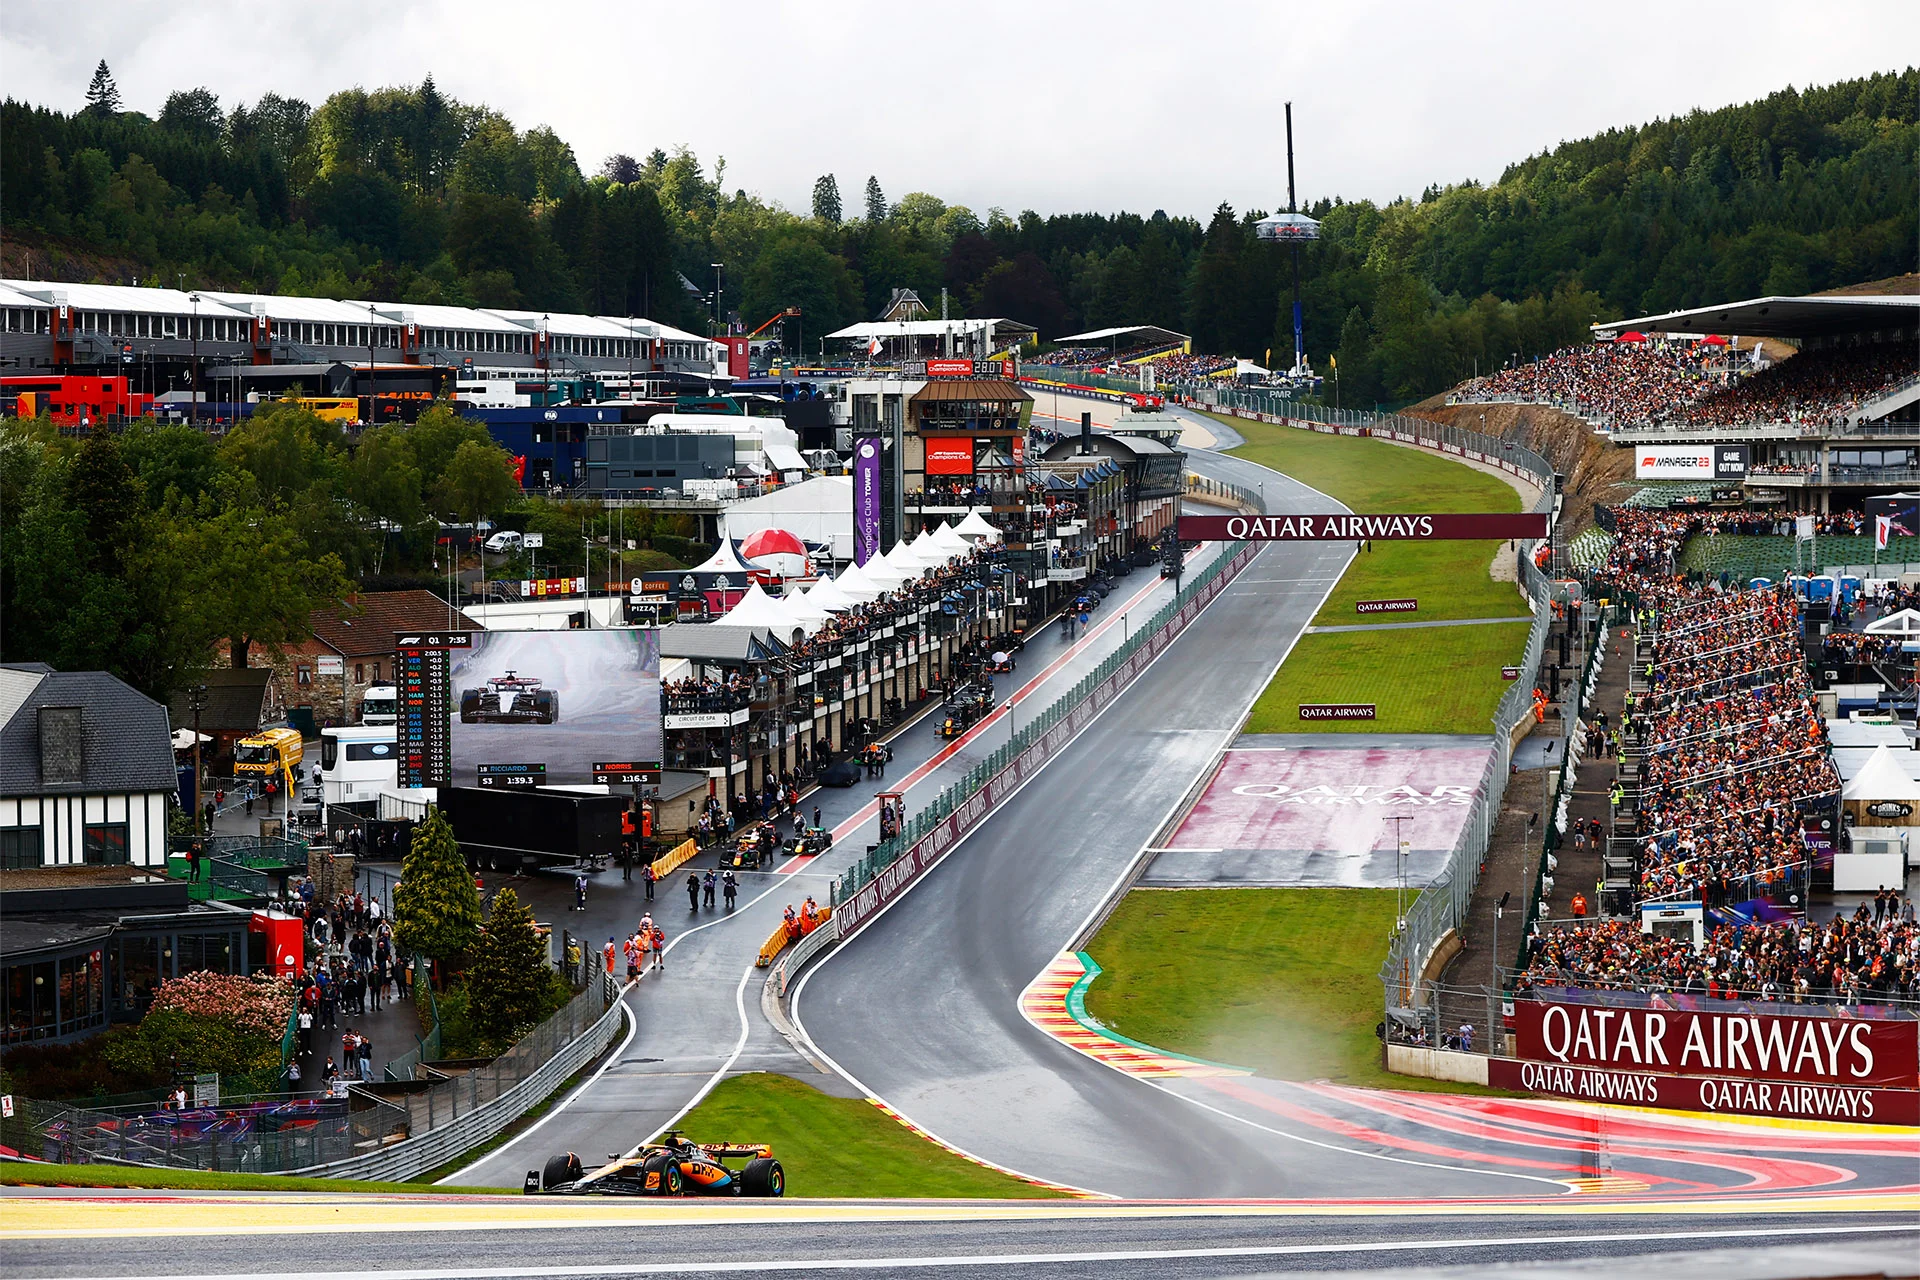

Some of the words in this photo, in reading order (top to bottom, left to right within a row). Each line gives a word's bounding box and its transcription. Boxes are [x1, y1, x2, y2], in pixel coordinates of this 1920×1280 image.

[61, 306, 66, 317] 3
[1719, 463, 1730, 472] OUT
[1731, 463, 1744, 472] NOW
[1723, 452, 1739, 461] GAME
[865, 518, 873, 562] hampions
[1227, 517, 1315, 539] QATAR
[1322, 516, 1433, 537] AIRWAYS
[1301, 709, 1332, 718] QATAR
[1334, 708, 1373, 716] AIRWAYS
[1232, 784, 1473, 797] QATAR
[956, 804, 971, 833] QATAR
[1878, 803, 1900, 812] DRINKS
[919, 840, 934, 866] QATAR
[934, 821, 953, 854] AIRWAYS
[879, 872, 896, 902] QATAR
[895, 852, 916, 886] AIRWAYS
[837, 904, 858, 934] QATAR
[856, 883, 878, 920] AIRWAYS
[1542, 1006, 1670, 1066] QATAR
[1680, 1014, 1873, 1078] AIRWAYS
[1521, 1063, 1574, 1094] QATAR
[1578, 1072, 1658, 1102] AIRWAYS
[1700, 1080, 1772, 1112] QATAR
[1779, 1086, 1873, 1118] AIRWAYS
